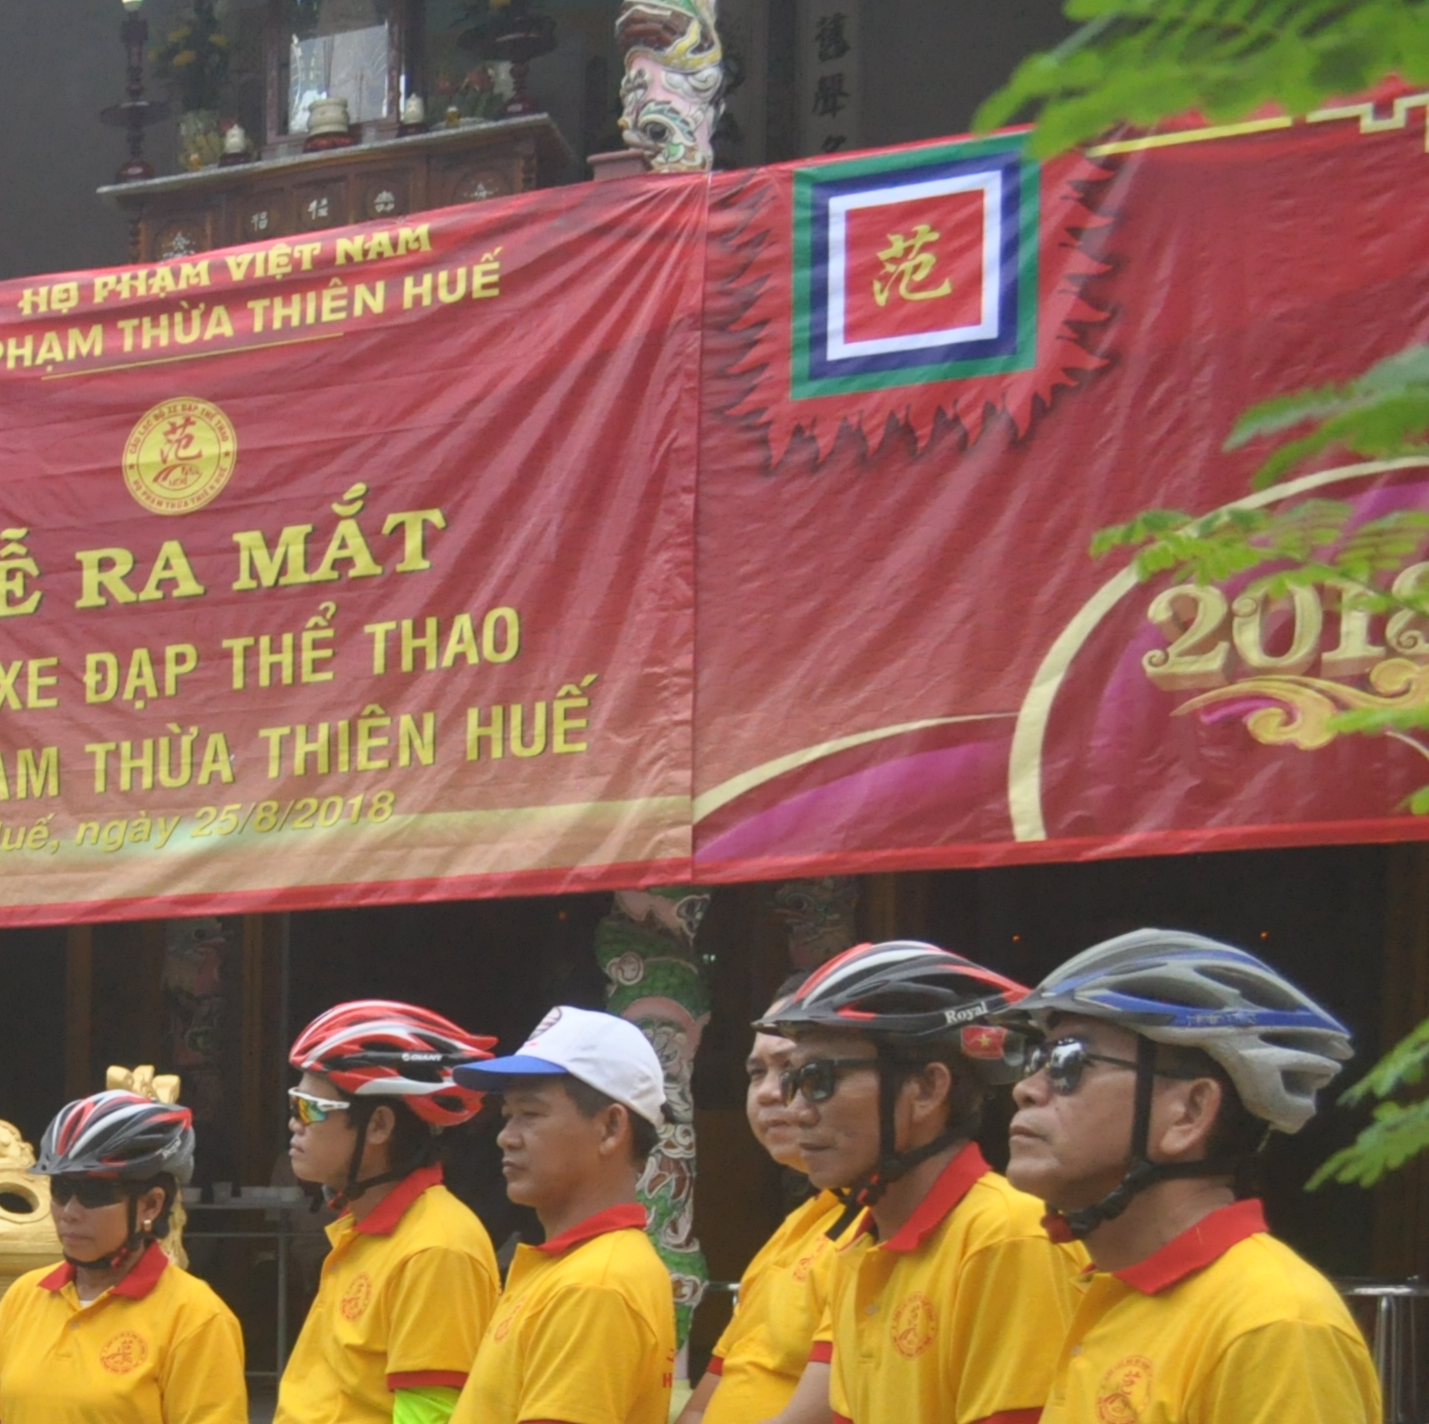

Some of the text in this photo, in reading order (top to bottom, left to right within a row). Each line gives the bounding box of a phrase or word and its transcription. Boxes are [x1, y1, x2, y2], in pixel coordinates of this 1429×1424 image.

[94, 259, 210, 303] PHẠM
[225, 242, 320, 282] VIỆT
[335, 223, 432, 265] NAM
[117, 302, 234, 352] THỪA
[247, 280, 385, 333] THIÊN
[402, 245, 505, 309] HUẾ
[873, 224, 952, 307] 范
[75, 546, 203, 609] RA
[232, 483, 446, 591] MẮT
[83, 640, 198, 709] ĐẠP
[222, 601, 338, 689] THỂ
[364, 605, 521, 676] THAO
[85, 722, 234, 794] THỪA
[259, 706, 436, 779] THIÊN
[467, 673, 600, 760] HUẾ
[75, 810, 180, 853] ngày
[190, 789, 396, 839] 25/8/2018
[944, 1000, 989, 1024] Royal
